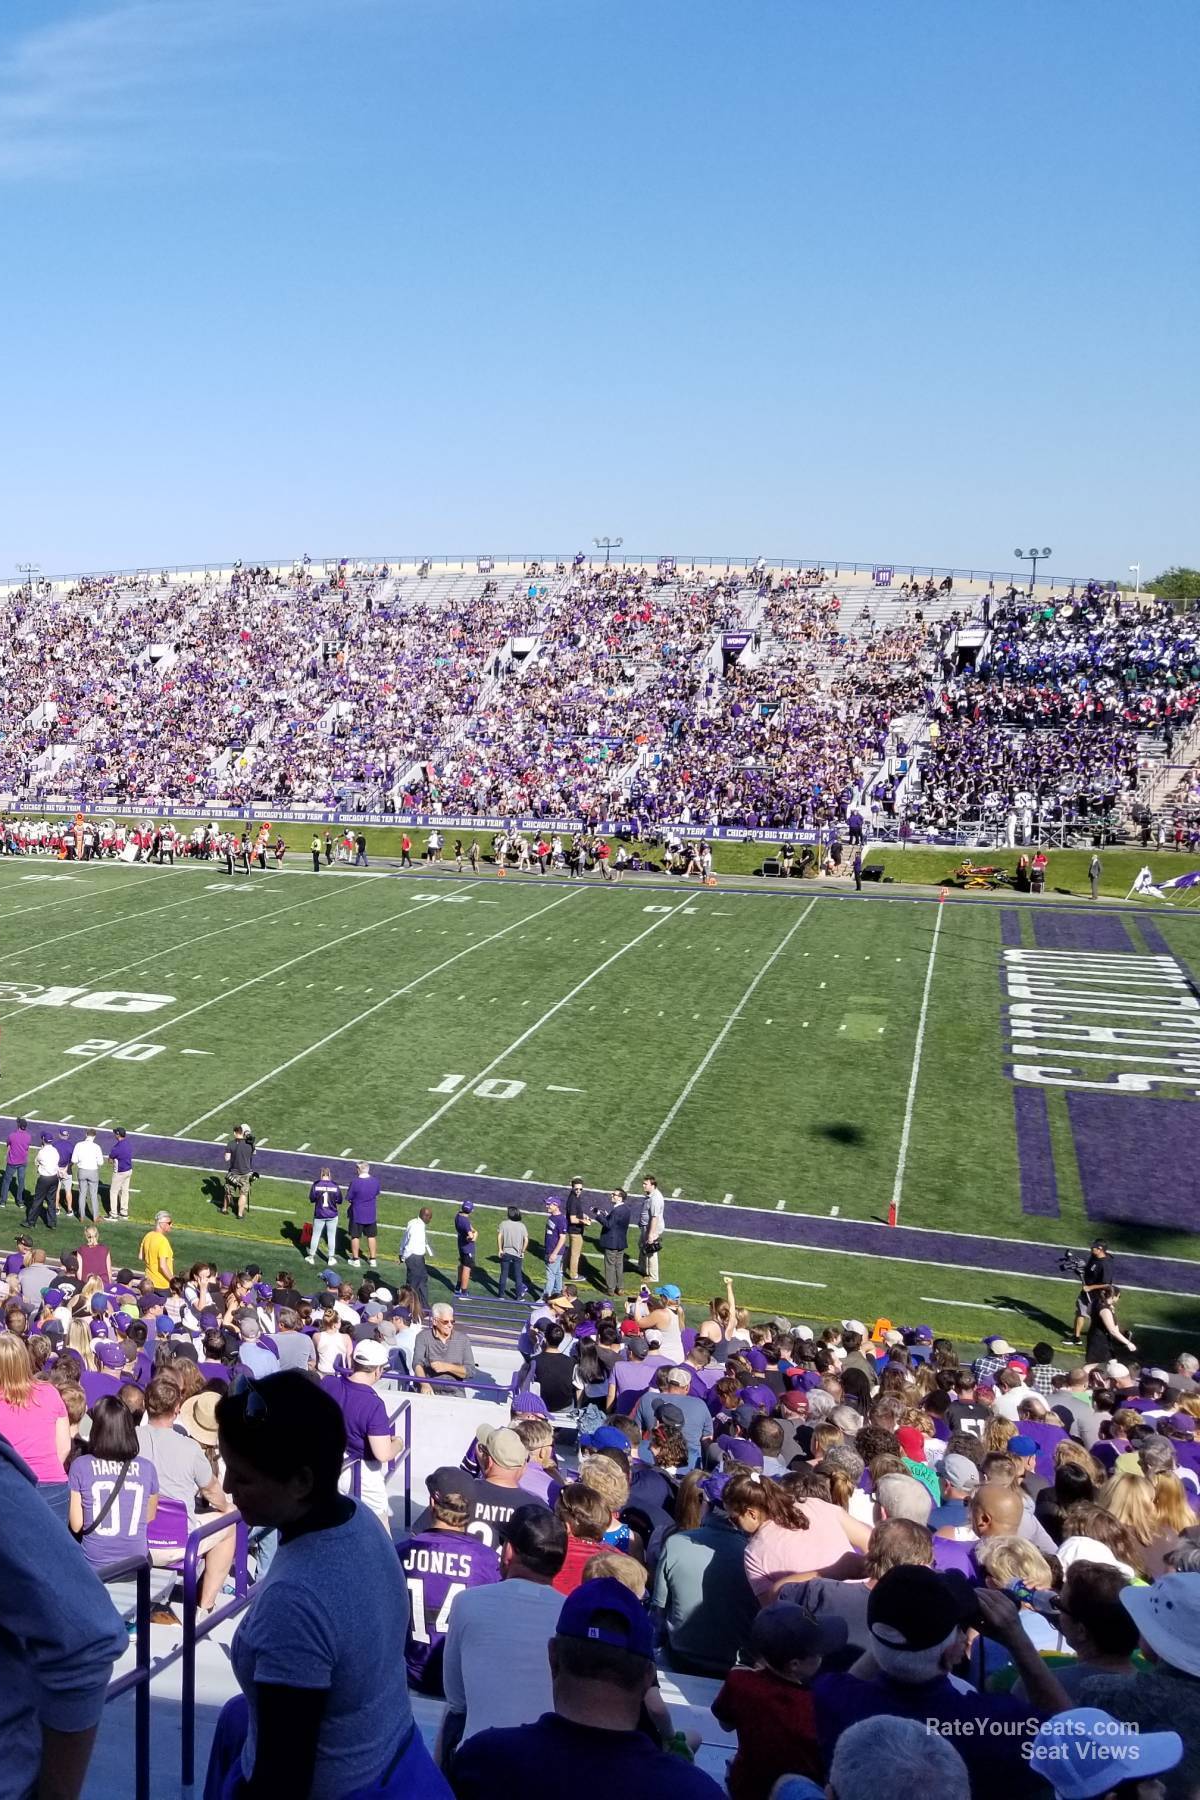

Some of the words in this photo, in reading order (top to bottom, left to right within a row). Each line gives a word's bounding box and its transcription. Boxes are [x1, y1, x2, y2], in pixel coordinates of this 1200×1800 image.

[163, 807, 168, 815] N
[244, 810, 249, 818] N
[417, 816, 422, 825] N
[428, 817, 459, 826] CHICAGO'S
[473, 818, 485, 826] TEN
[486, 819, 504, 828] TEAM
[522, 820, 555, 829] CHICAGO'S
[569, 822, 582, 830] TEN
[687, 827, 706, 837] TEAM
[713, 828, 720, 837] N
[726, 829, 763, 839] CHICAGO'S
[764, 830, 777, 839] BIG
[778, 831, 793, 840] TEN
[795, 831, 816, 841] TEAM
[63, 1038, 167, 1061] 20
[427, 1073, 527, 1099] 10
[321, 1191, 329, 1208] 1
[403, 1549, 472, 1578] JONES
